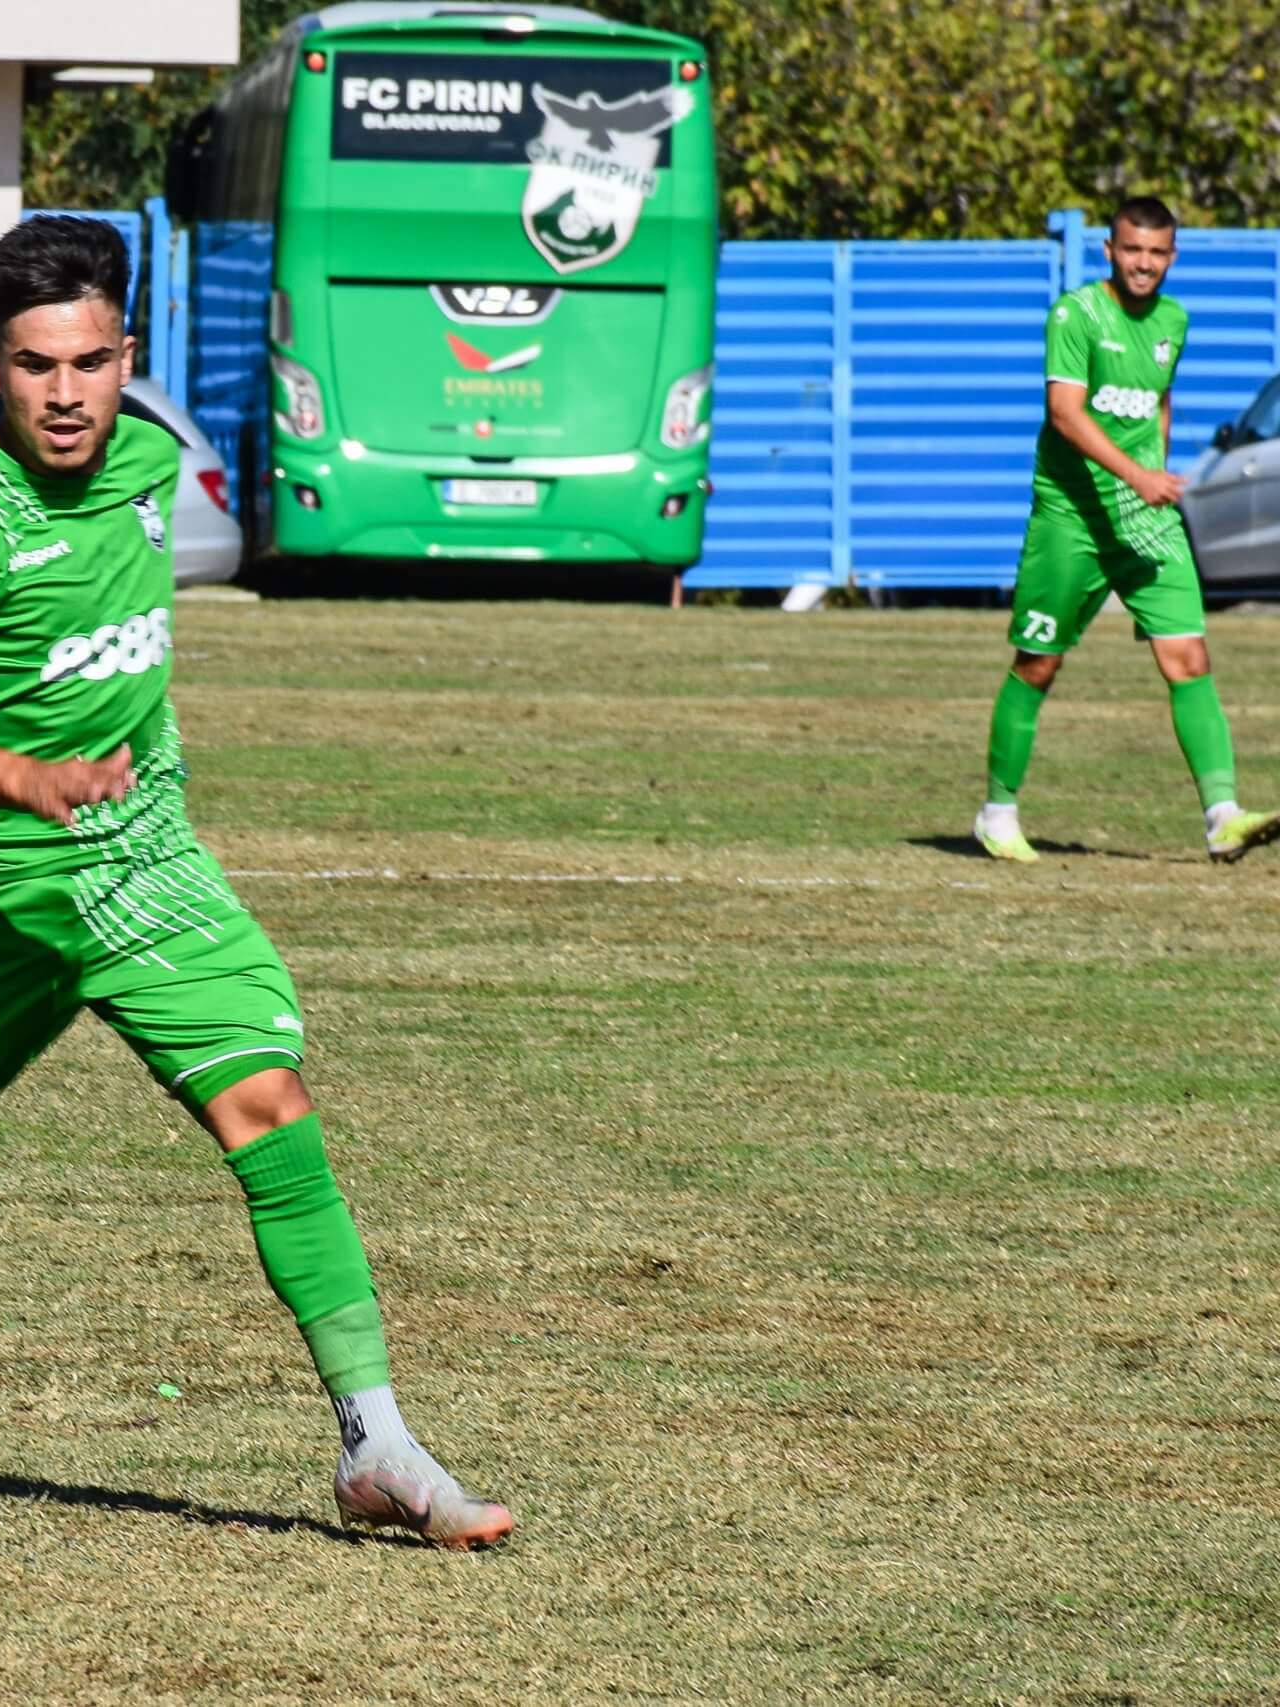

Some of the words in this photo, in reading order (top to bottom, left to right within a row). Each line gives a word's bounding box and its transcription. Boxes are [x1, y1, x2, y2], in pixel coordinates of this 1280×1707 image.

[342, 77, 400, 110] FC
[406, 78, 523, 114] PIRIN
[1023, 609, 1057, 643] 73
